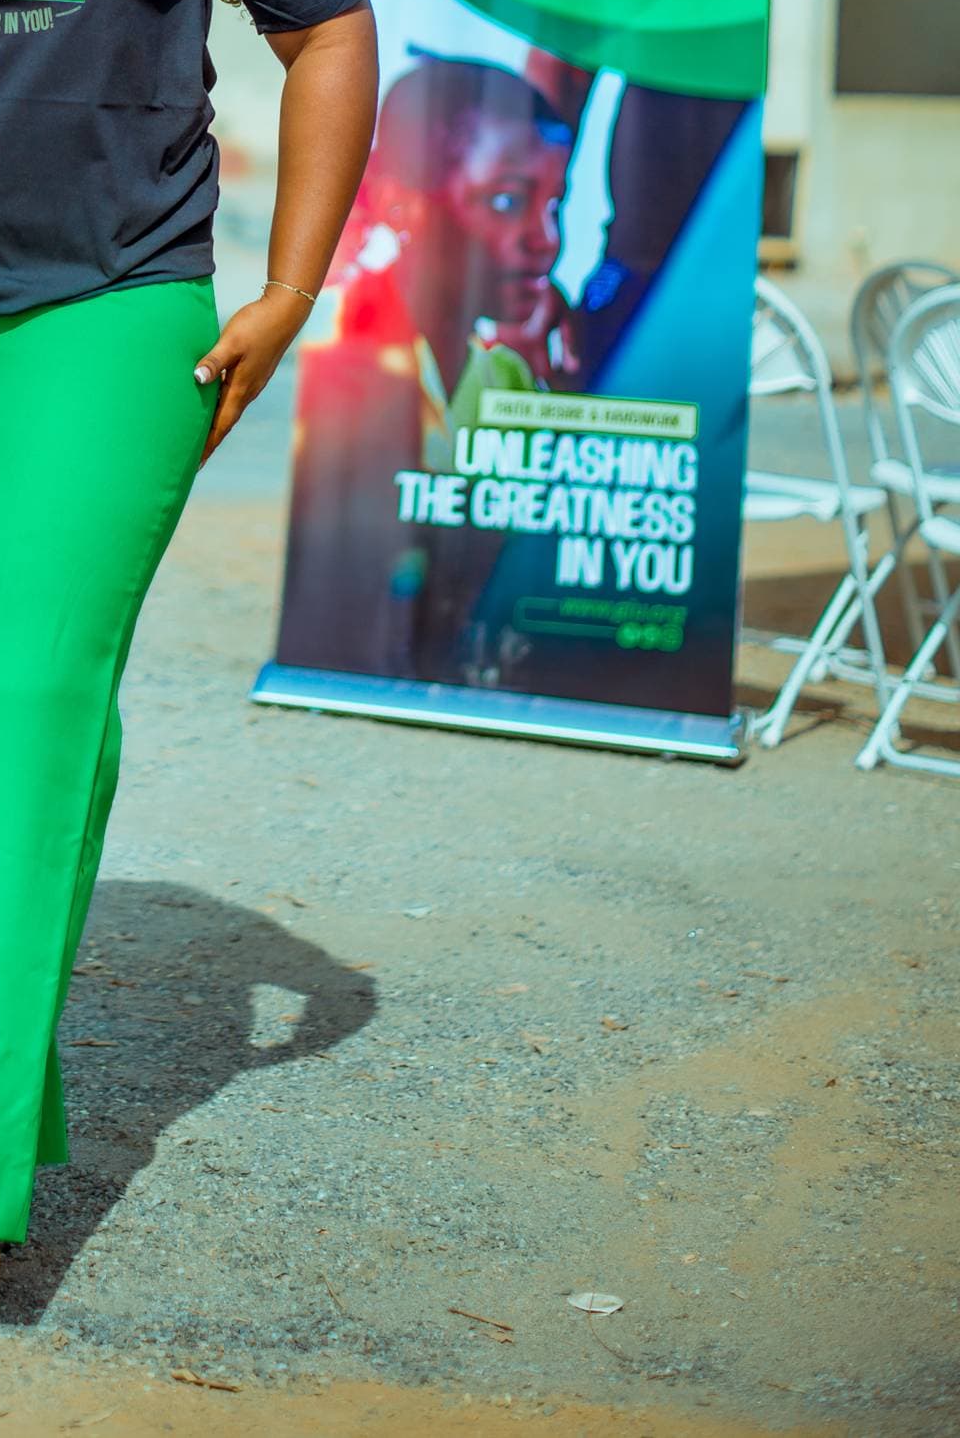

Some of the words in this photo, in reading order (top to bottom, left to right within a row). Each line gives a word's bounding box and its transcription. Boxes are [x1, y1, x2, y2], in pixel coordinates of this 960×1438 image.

[4, 12, 19, 34] IN
[22, 7, 54, 33] YOU!
[455, 426, 698, 491] UNLEASHING
[395, 471, 467, 526] THE
[470, 479, 696, 543] GREATNESS
[555, 536, 604, 587] IN
[611, 541, 694, 594] YOU
